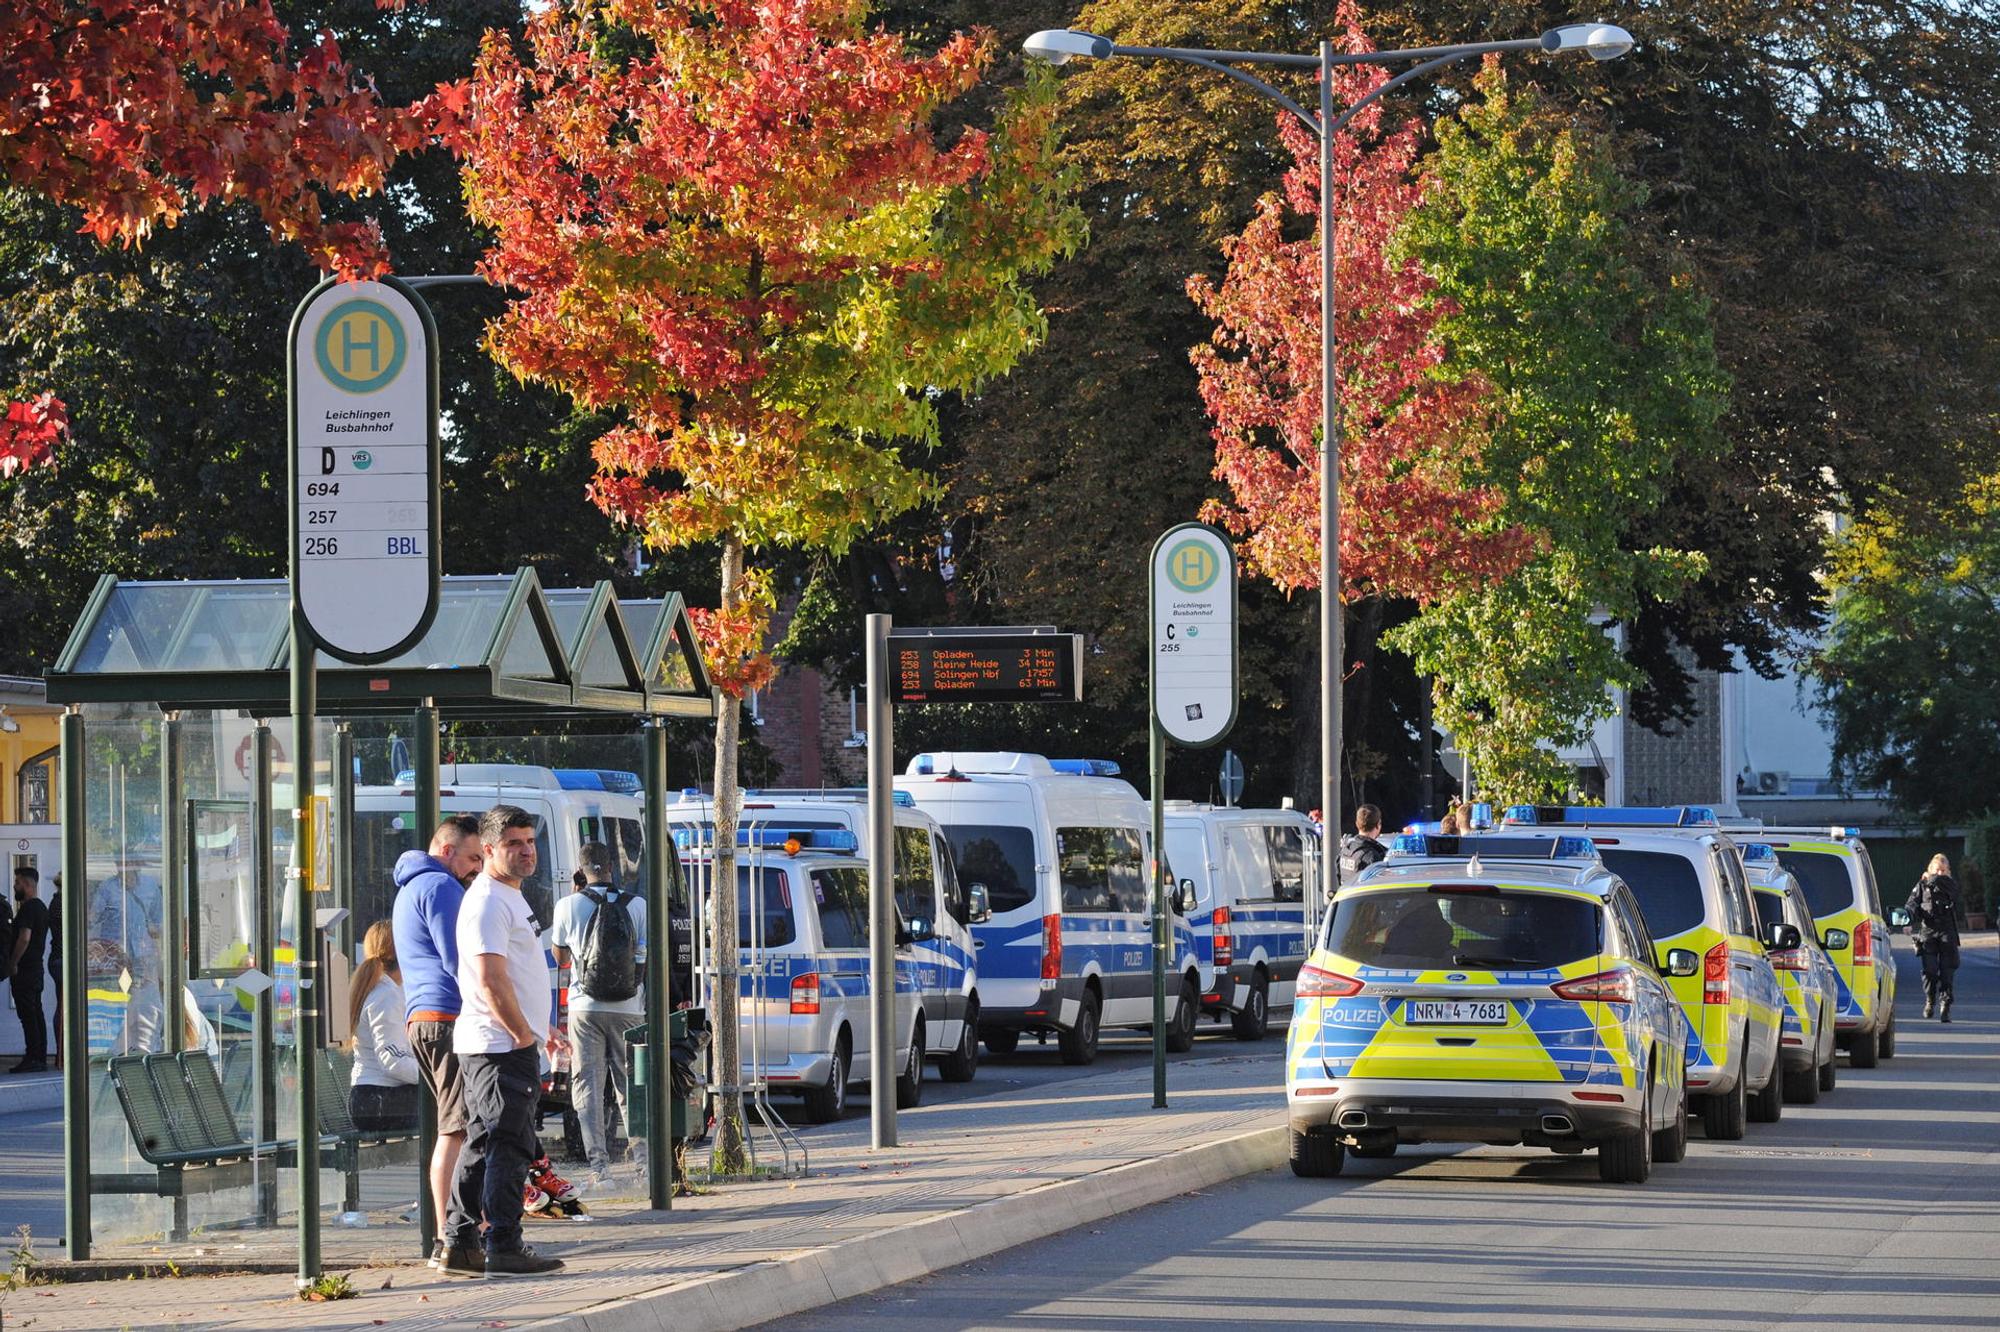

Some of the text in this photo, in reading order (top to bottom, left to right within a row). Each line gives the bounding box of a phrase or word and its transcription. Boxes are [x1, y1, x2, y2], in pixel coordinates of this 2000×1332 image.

[342, 320, 379, 372] H
[325, 410, 391, 421] Leichlingen
[325, 422, 394, 433] Busbahnhof
[322, 446, 335, 475] D
[307, 482, 340, 497] 694
[308, 510, 337, 524] 257
[305, 537, 338, 556] 256
[387, 537, 422, 555] BBL
[1181, 551, 1204, 581] H
[1173, 602, 1212, 610] Leichlingen
[1166, 623, 1176, 640] C
[900, 649, 1055, 660] 253 Opladen 3 Min
[1160, 643, 1181, 653] 255
[901, 658, 1055, 670] 258 Kleine Heide 34 Min
[901, 671, 920, 680] 694
[934, 669, 979, 680] Solingen
[982, 669, 1000, 679] Hbf
[902, 679, 1056, 690] 253 Opladen 63 Min
[1123, 951, 1144, 967] POLIZEI
[1323, 1008, 1382, 1024] POLIZEI
[1415, 1003, 1444, 1019] NRW
